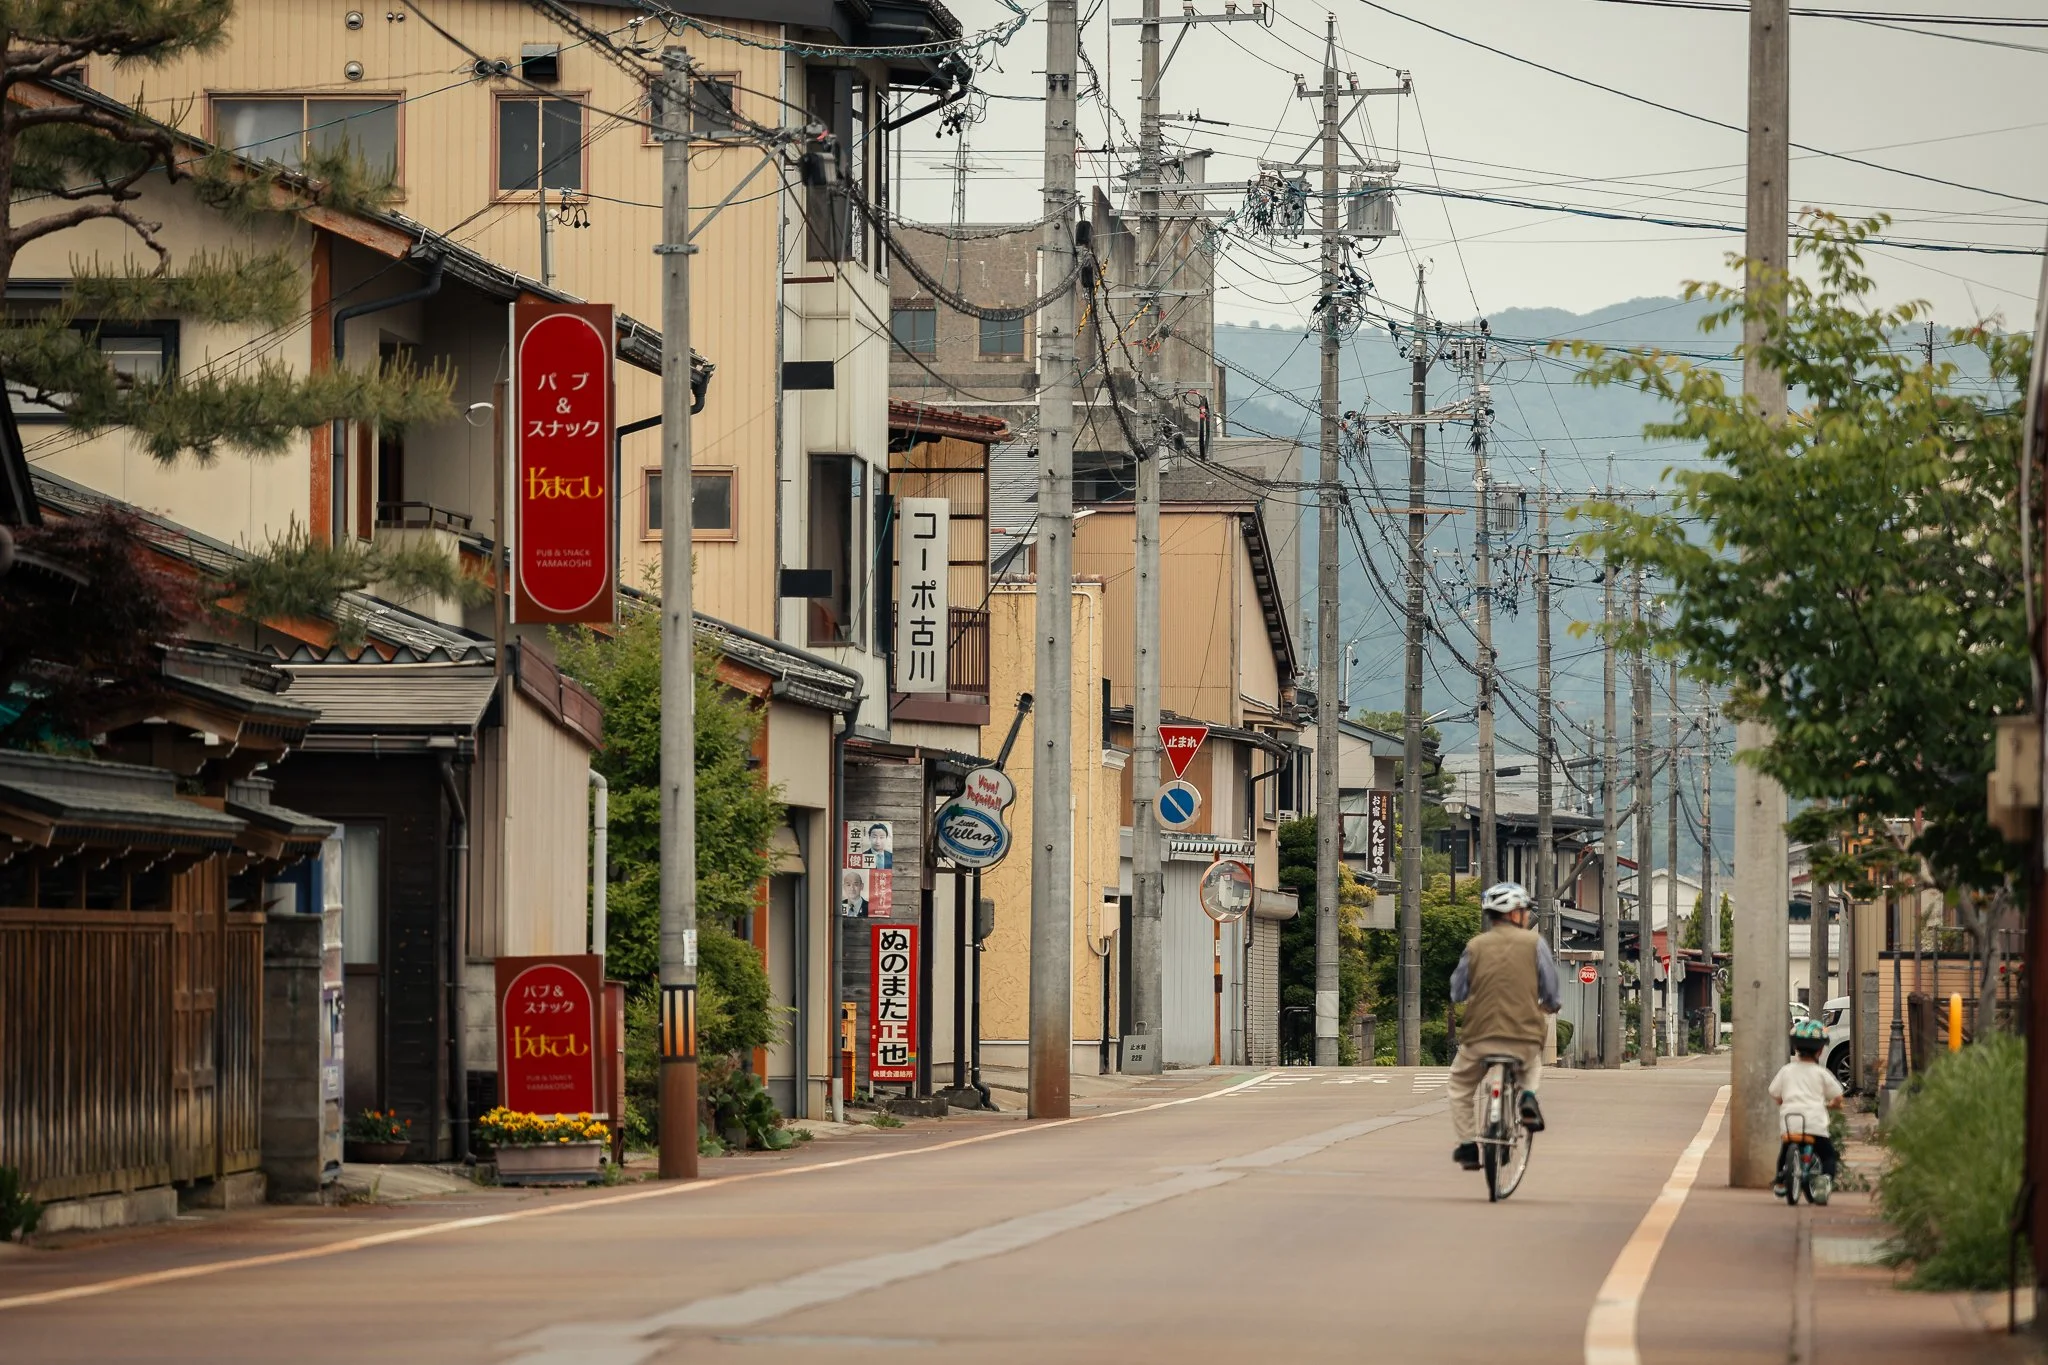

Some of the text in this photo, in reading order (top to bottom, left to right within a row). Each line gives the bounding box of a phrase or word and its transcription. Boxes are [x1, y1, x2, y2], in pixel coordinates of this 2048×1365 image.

[537, 372, 590, 391] パブ
[556, 397, 572, 414] &
[527, 420, 600, 437] スナック
[536, 559, 592, 568] YAMAKOSHI
[909, 512, 937, 682] コーポ古川
[1167, 735, 1198, 748] 止まれ
[955, 819, 978, 828] Little
[943, 825, 999, 846] Village
[553, 985, 564, 997] &
[879, 930, 909, 1066] ぬのまた正也
[525, 1000, 575, 1014] スナック
